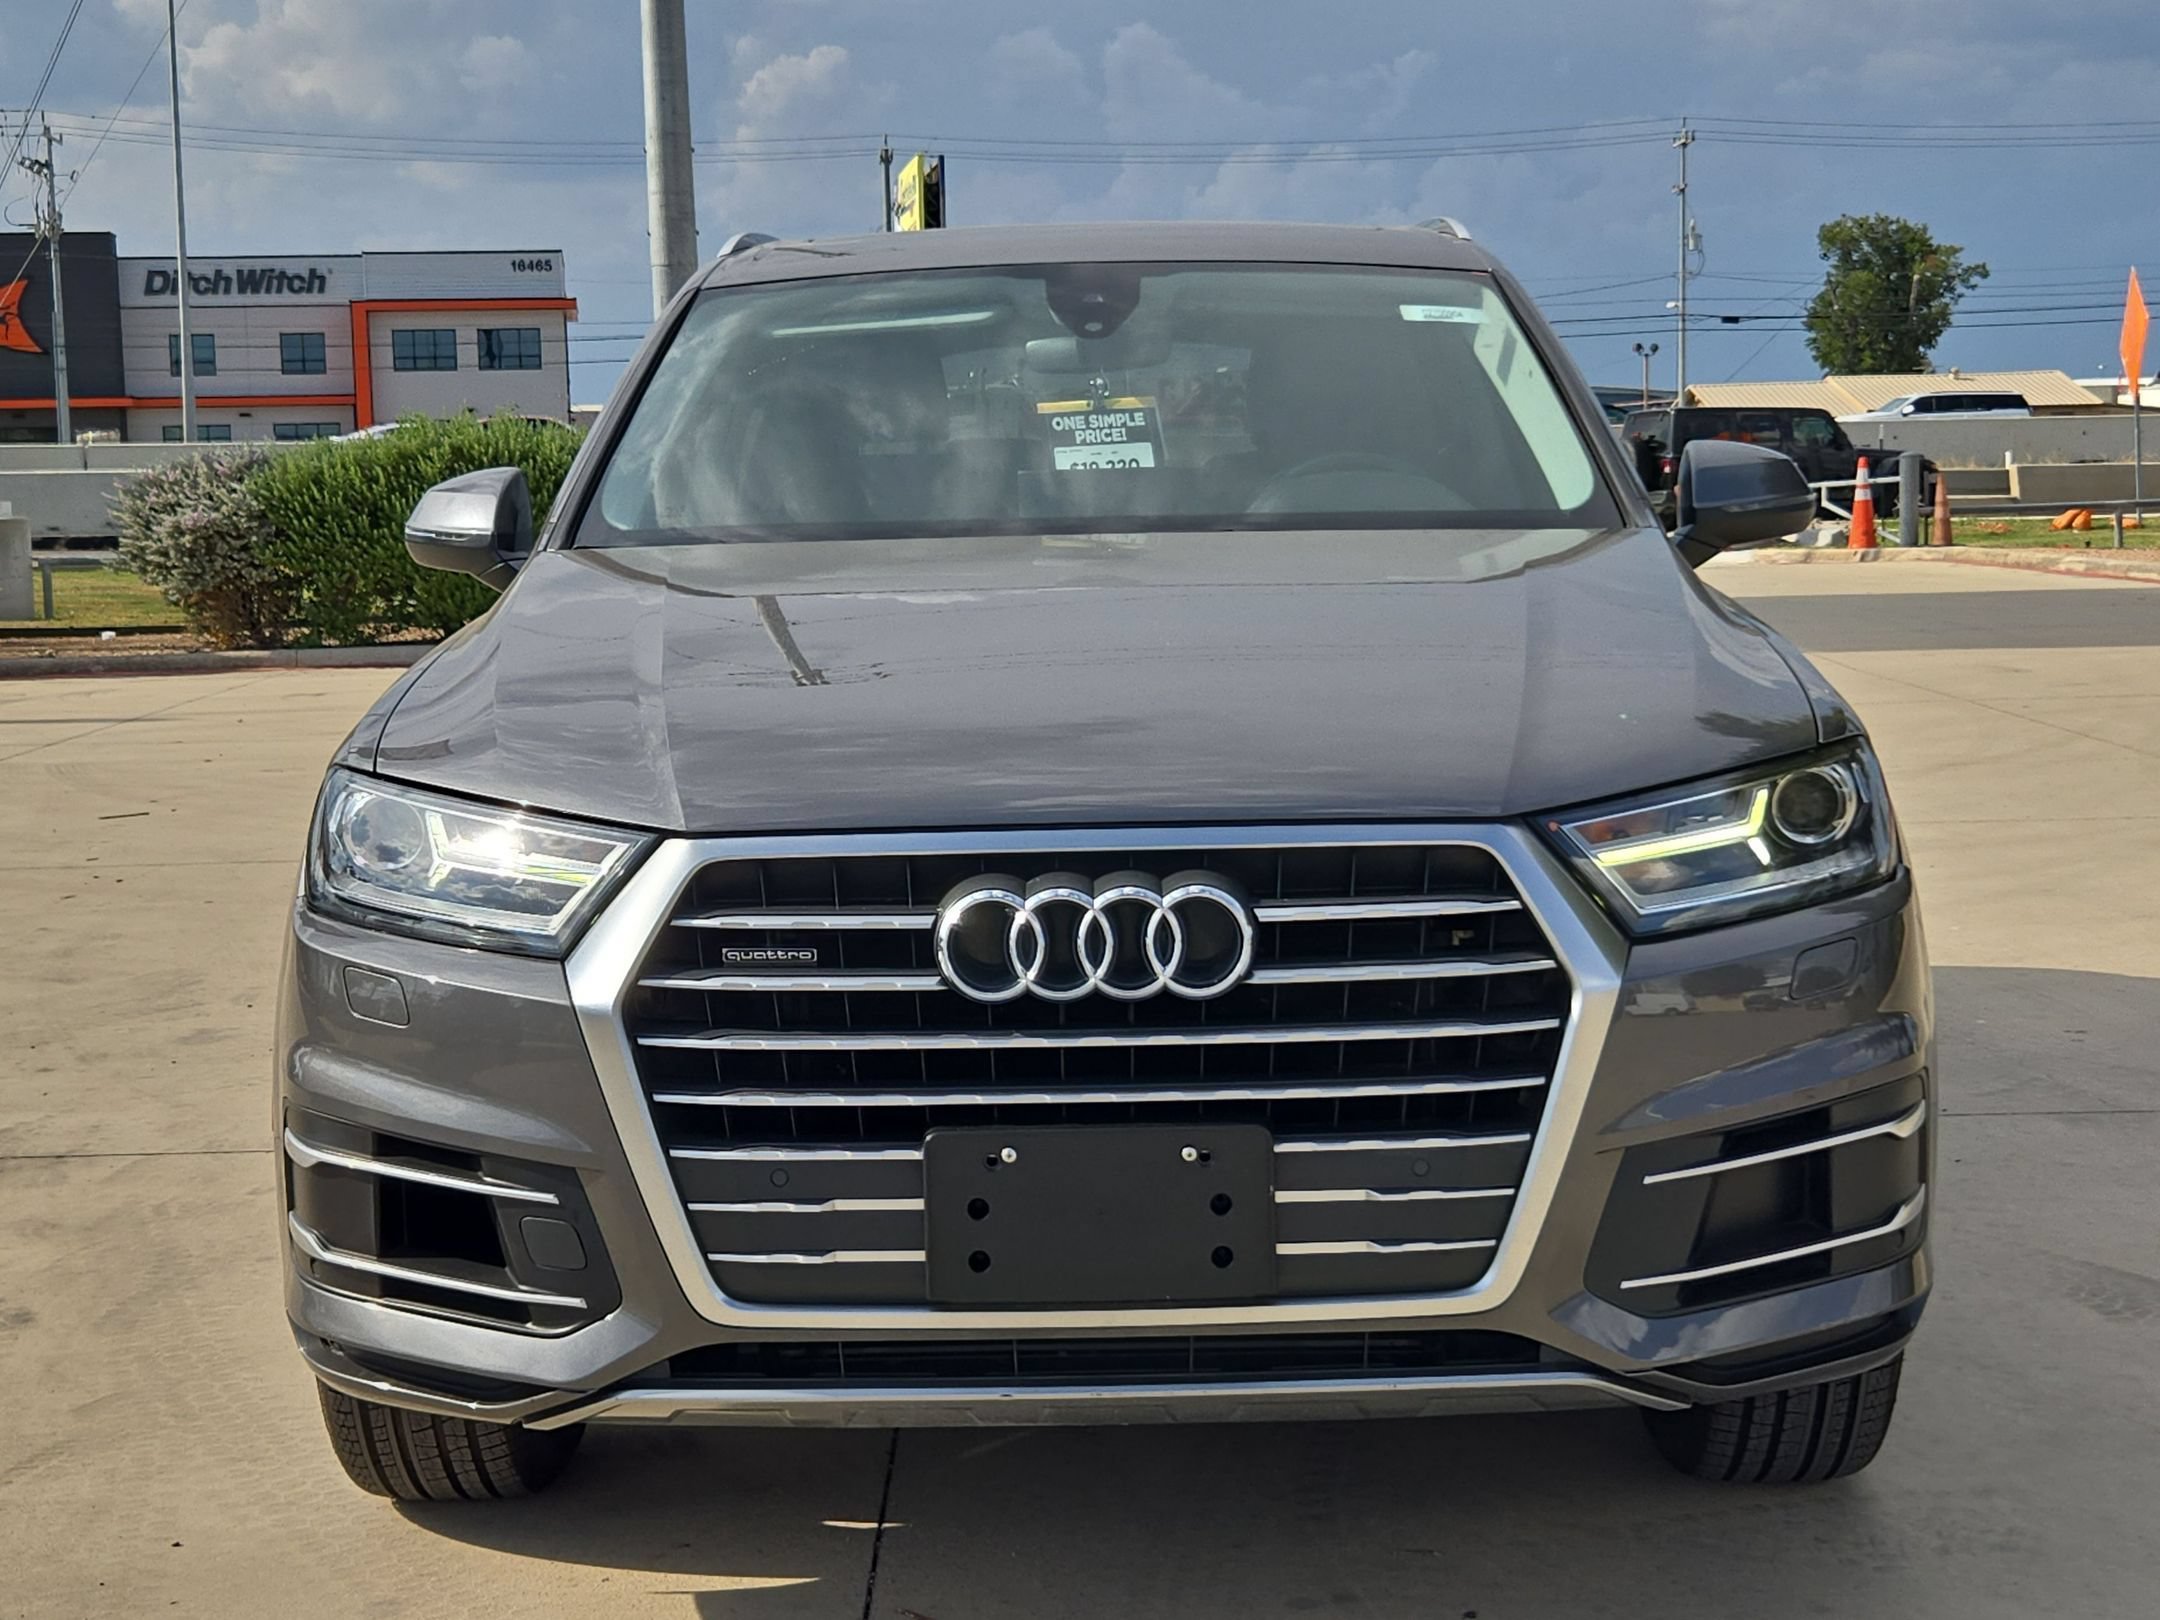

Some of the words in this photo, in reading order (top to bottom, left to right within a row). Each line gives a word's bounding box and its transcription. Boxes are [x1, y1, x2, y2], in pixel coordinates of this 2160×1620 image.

[511, 259, 552, 272] 16465
[235, 268, 327, 296] Witch
[1052, 416, 1086, 431] ONE
[1088, 412, 1145, 428] SIMPLE
[1075, 427, 1127, 444] PRICE!
[727, 950, 812, 961] quattro
